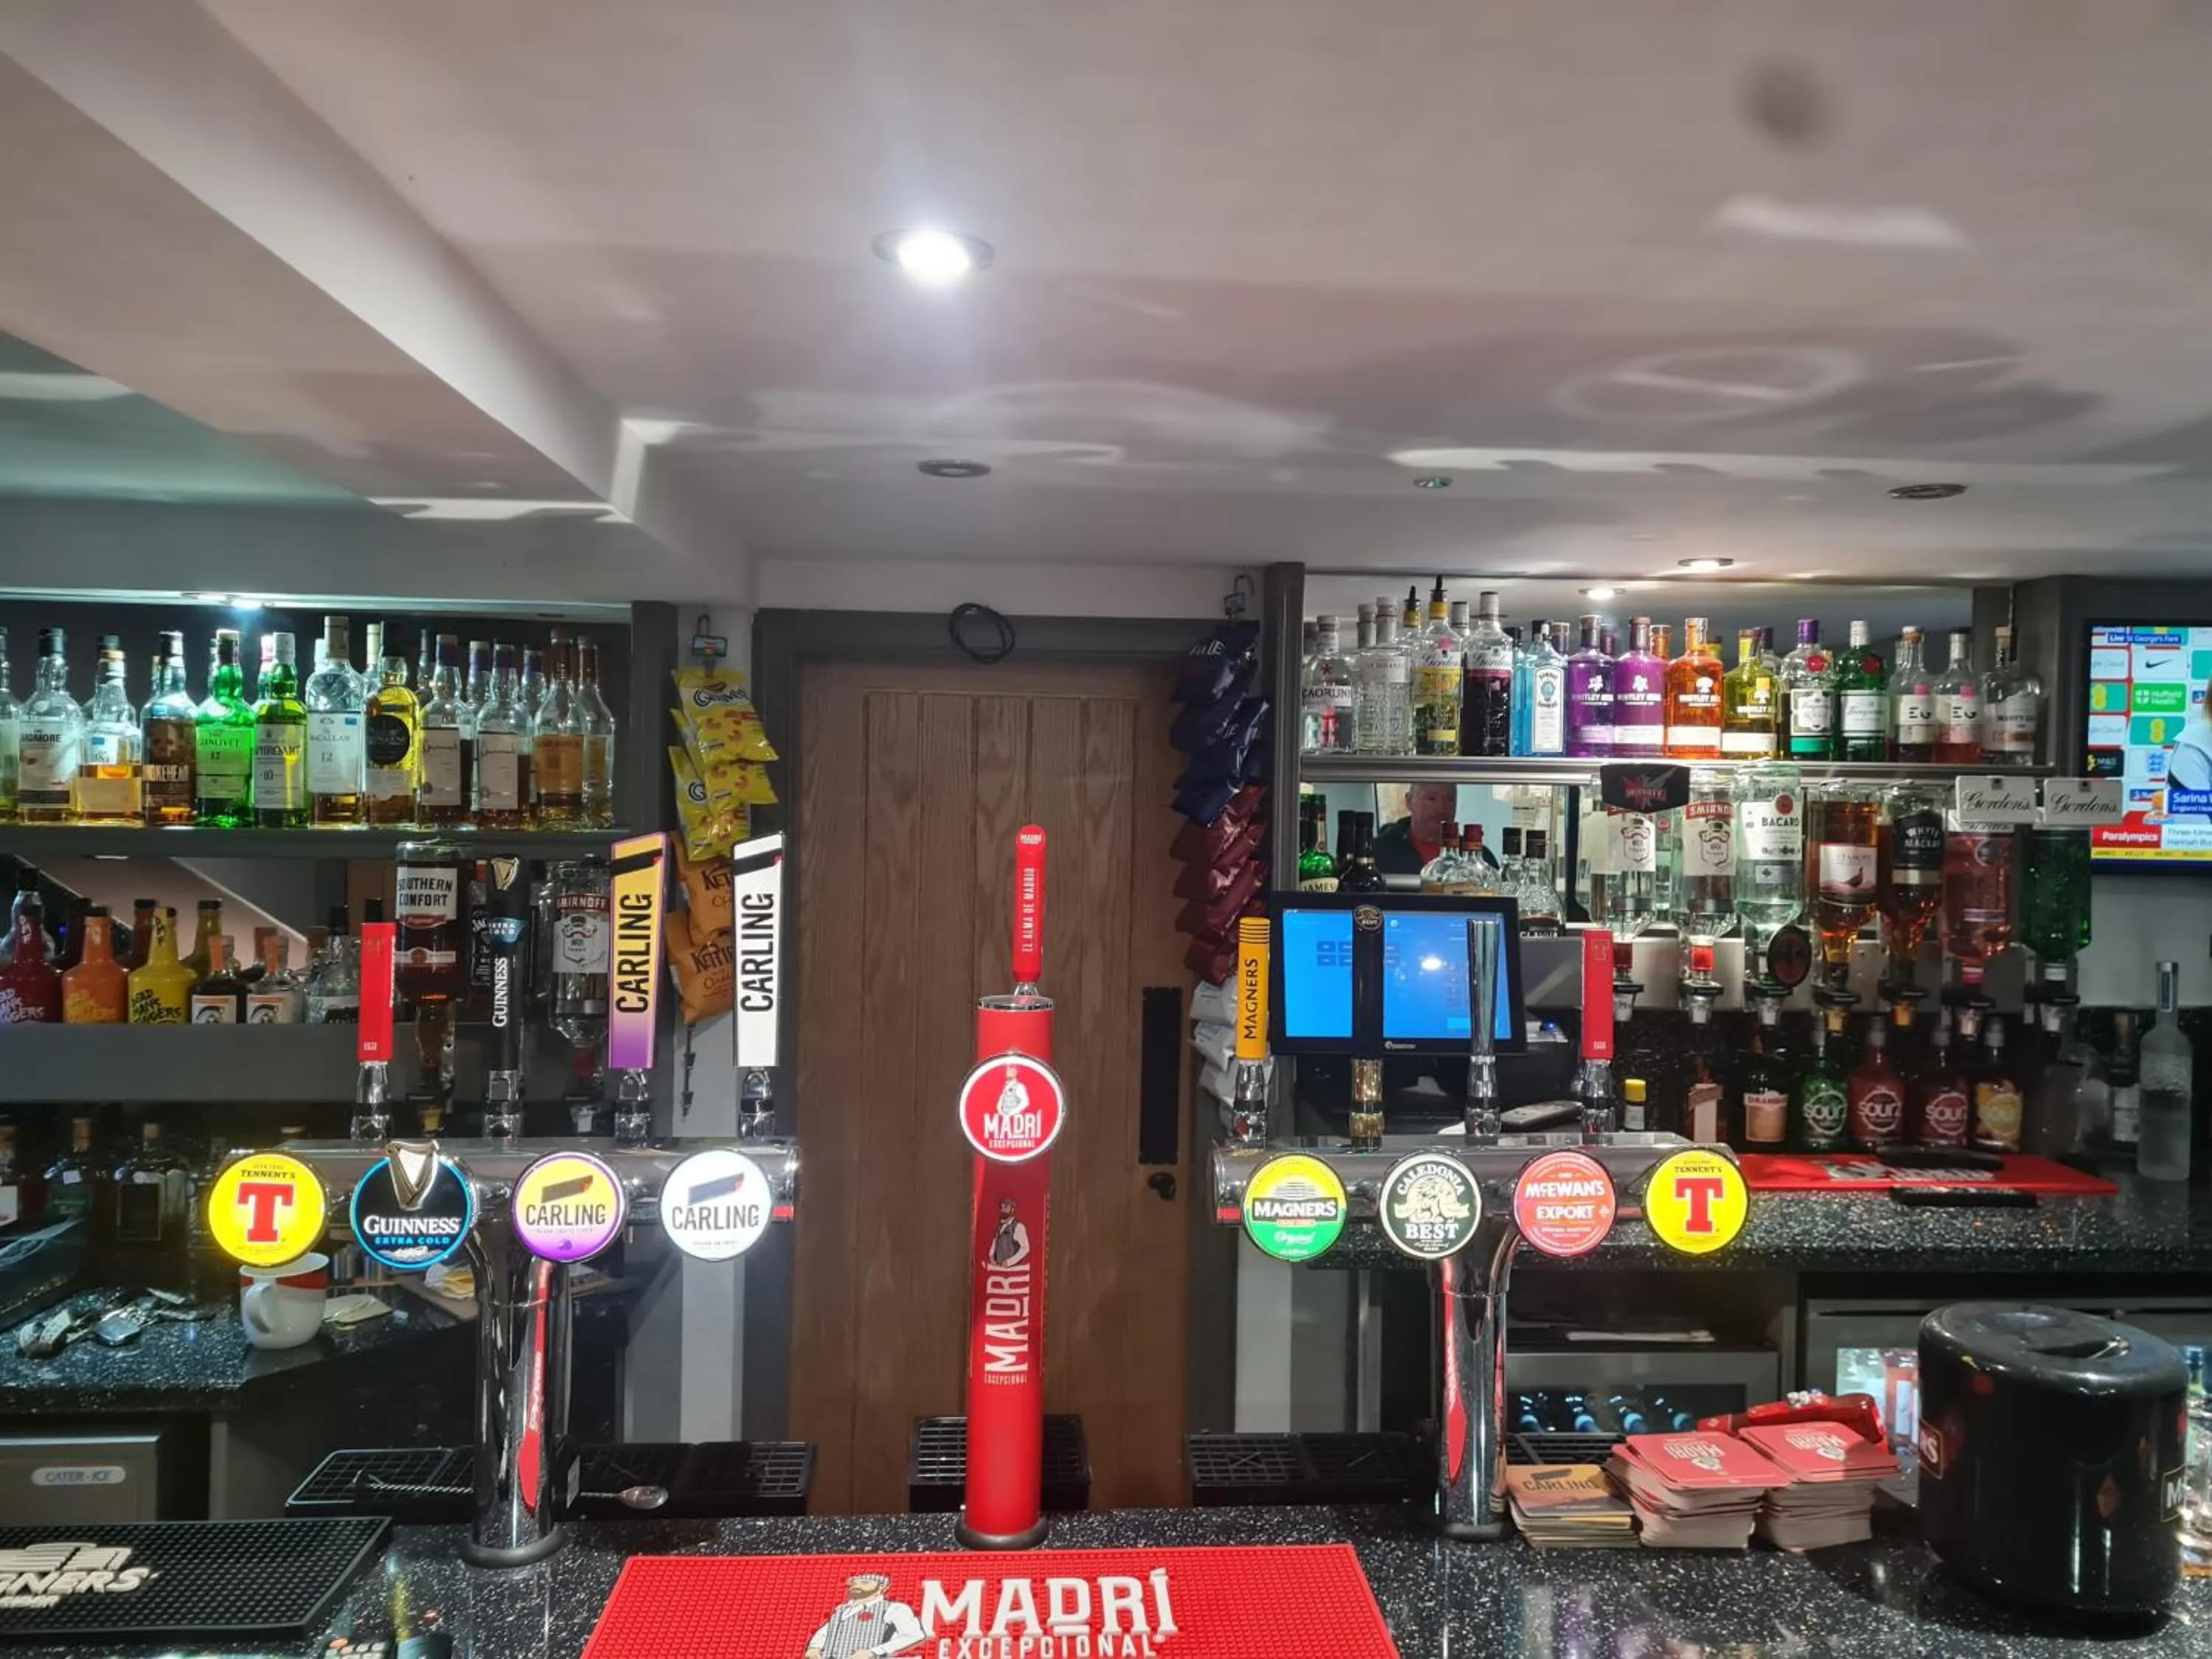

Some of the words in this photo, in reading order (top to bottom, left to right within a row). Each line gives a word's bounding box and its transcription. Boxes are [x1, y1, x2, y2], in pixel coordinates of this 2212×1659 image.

[2172, 793, 2207, 804] Sarina
[1689, 803, 1731, 815] SMIRNO
[1761, 816, 1800, 827] BACARD
[2102, 831, 2159, 843] Paralympics
[397, 877, 453, 892] SOUTHERN
[399, 893, 448, 907] COMFORT
[557, 897, 607, 909] SMIRNOFF
[616, 893, 653, 1014] CARLING
[740, 893, 774, 1012] CARLING
[492, 957, 509, 1028] GUINNESS
[1243, 958, 1259, 1040] MAGNERS
[983, 1109, 1043, 1139] MADRÍ
[237, 1182, 294, 1242] T
[525, 1203, 606, 1226] CARLING
[1253, 1200, 1338, 1218] MAGNERS
[1536, 1204, 1596, 1220] EXPORT
[1674, 1177, 1725, 1234] T
[364, 1215, 460, 1236] GUINNESS
[671, 1204, 759, 1231] CARLING
[1405, 1222, 1460, 1239] BEST
[375, 1237, 413, 1245] EXTRA
[418, 1236, 450, 1245] COLD
[44, 1471, 111, 1482] CATER-ICE
[1523, 1477, 1596, 1494] CARLING
[0, 1568, 150, 1595] NERS
[921, 1567, 1178, 1639] MADRÍ
[938, 1632, 1158, 1659] EXCEPCIONAL
